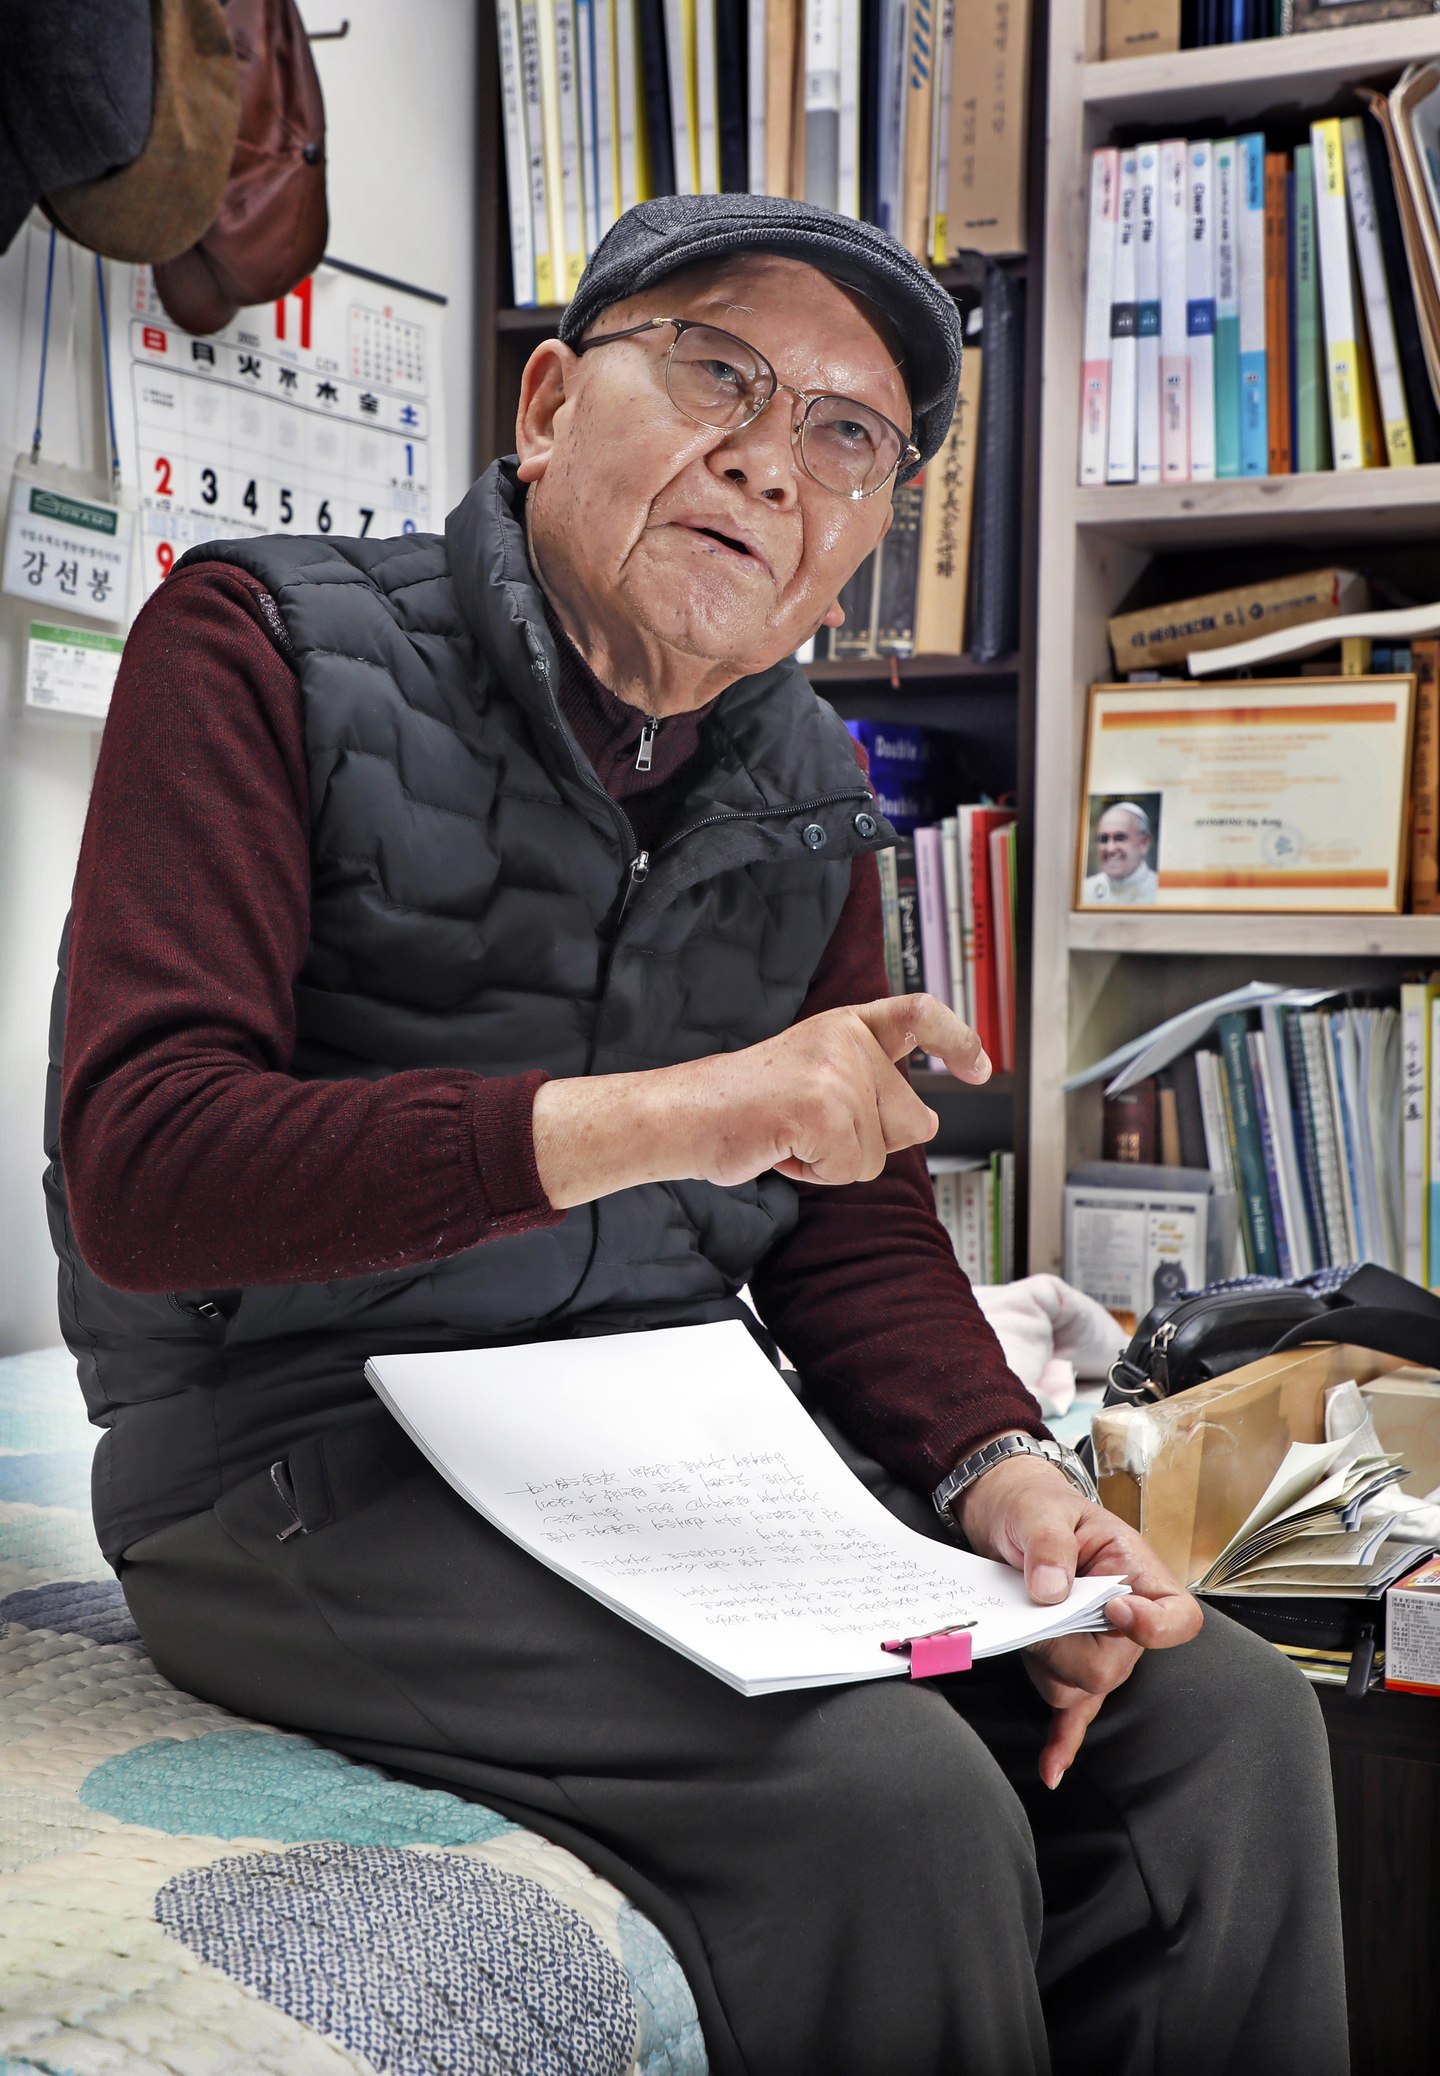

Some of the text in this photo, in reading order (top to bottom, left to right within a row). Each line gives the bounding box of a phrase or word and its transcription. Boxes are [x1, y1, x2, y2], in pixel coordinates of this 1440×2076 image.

[142, 325, 168, 353] 日
[237, 353, 263, 379] 火
[314, 380, 339, 402] 木
[357, 391, 380, 415] 金
[398, 404, 419, 427] 土
[404, 442, 415, 477] 1
[153, 456, 174, 497] 2
[201, 467, 218, 505] 3
[243, 478, 258, 517] 4
[279, 488, 294, 525] 5
[317, 500, 332, 534] 6
[358, 508, 374, 538] 7
[21, 549, 114, 604] 강선봉
[156, 541, 175, 580] 9
[875, 735, 917, 761] Double
